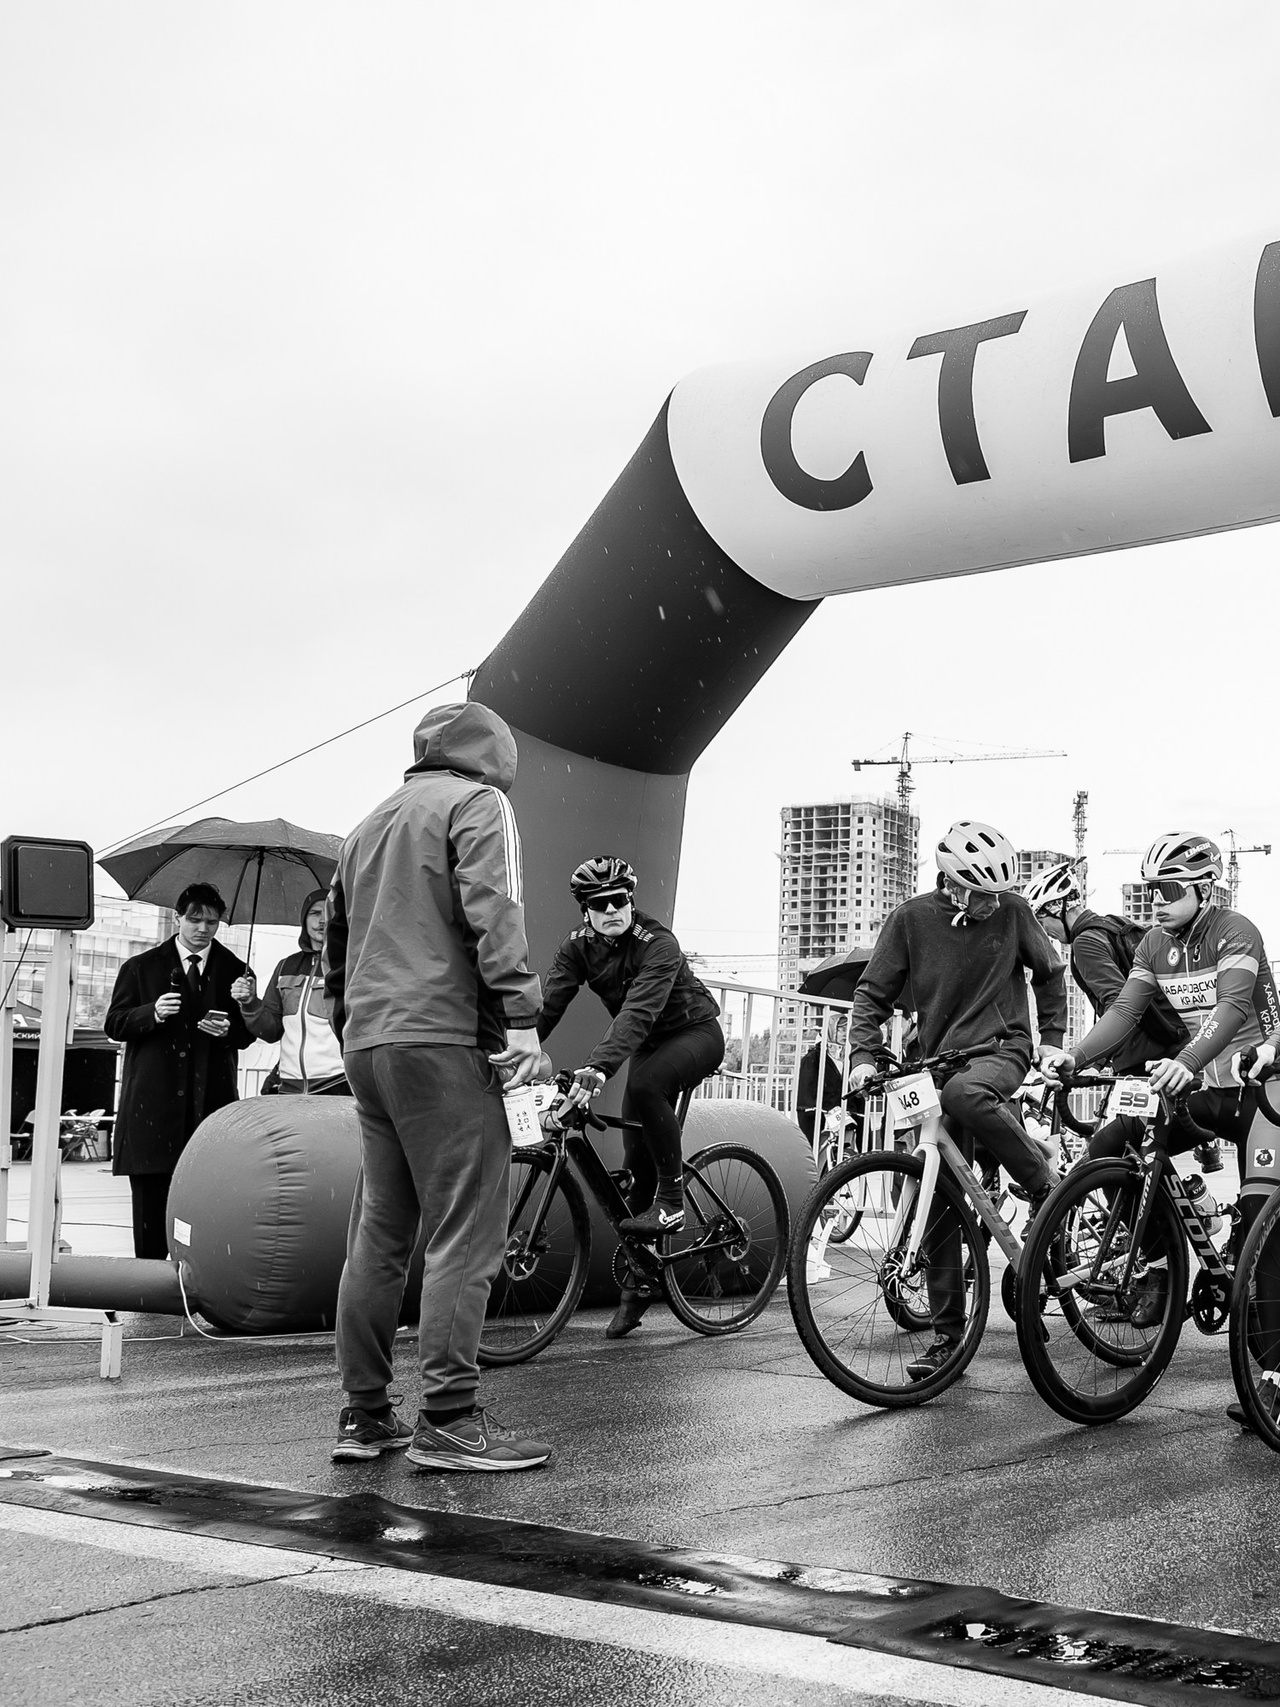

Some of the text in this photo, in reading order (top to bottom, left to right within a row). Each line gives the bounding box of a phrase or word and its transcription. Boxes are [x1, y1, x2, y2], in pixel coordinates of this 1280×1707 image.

[1181, 992, 1207, 1005] КРАЙ
[1119, 1091, 1149, 1108] 39
[1164, 1174, 1235, 1280] SCOTT
